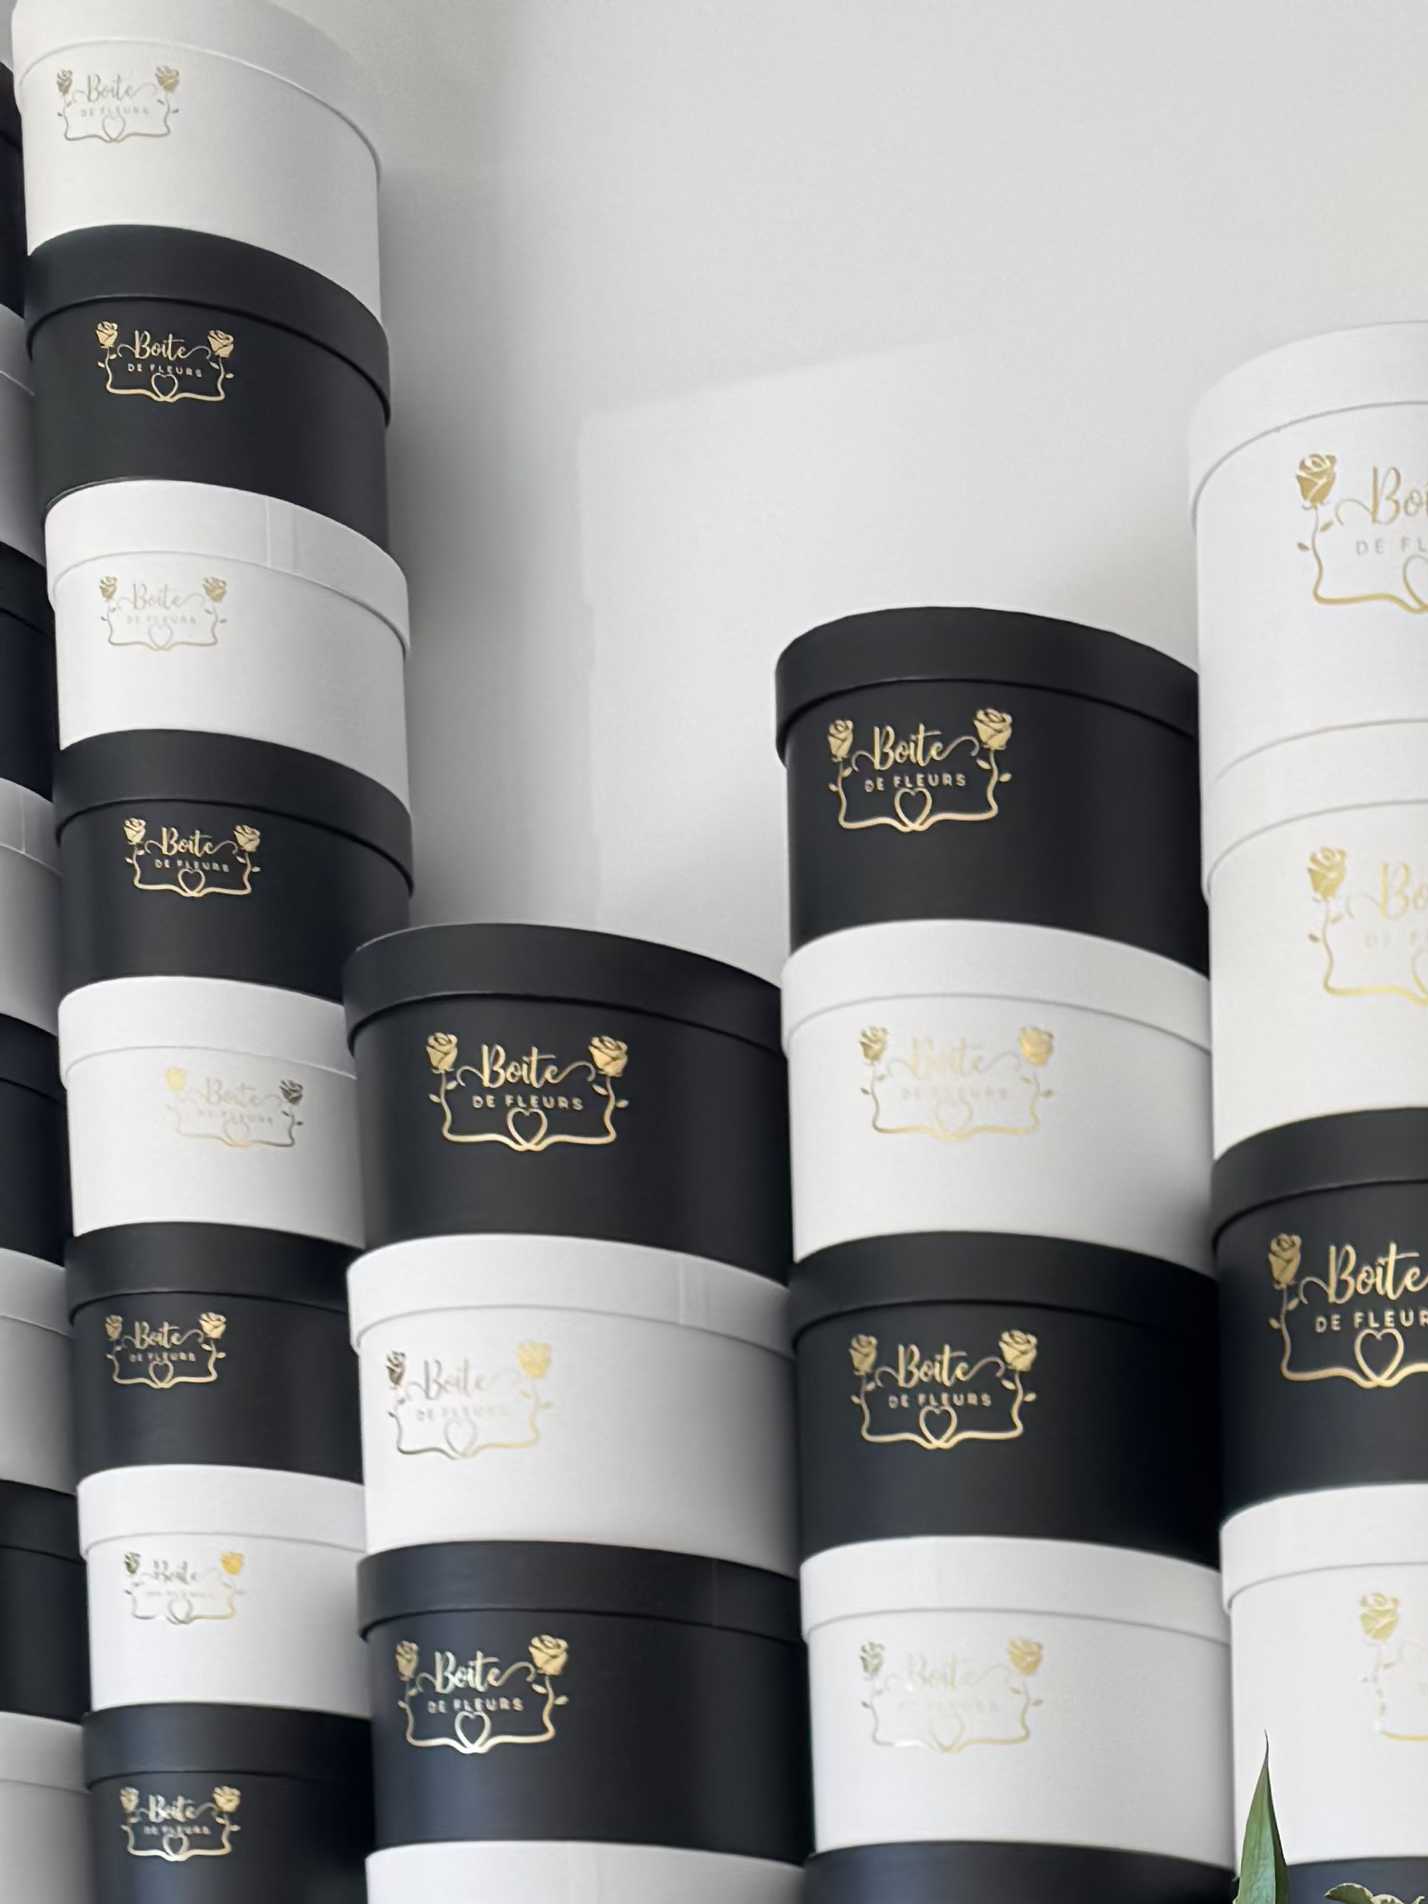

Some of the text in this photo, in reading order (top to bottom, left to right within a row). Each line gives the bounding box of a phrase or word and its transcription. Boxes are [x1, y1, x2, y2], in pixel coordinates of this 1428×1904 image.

[1356, 536, 1387, 556] DE
[864, 775, 966, 793] DE FLEURS
[472, 1094, 584, 1110] DE FLEURS
[1316, 1316, 1341, 1333] DE
[889, 1392, 992, 1408] DE FLEURS
